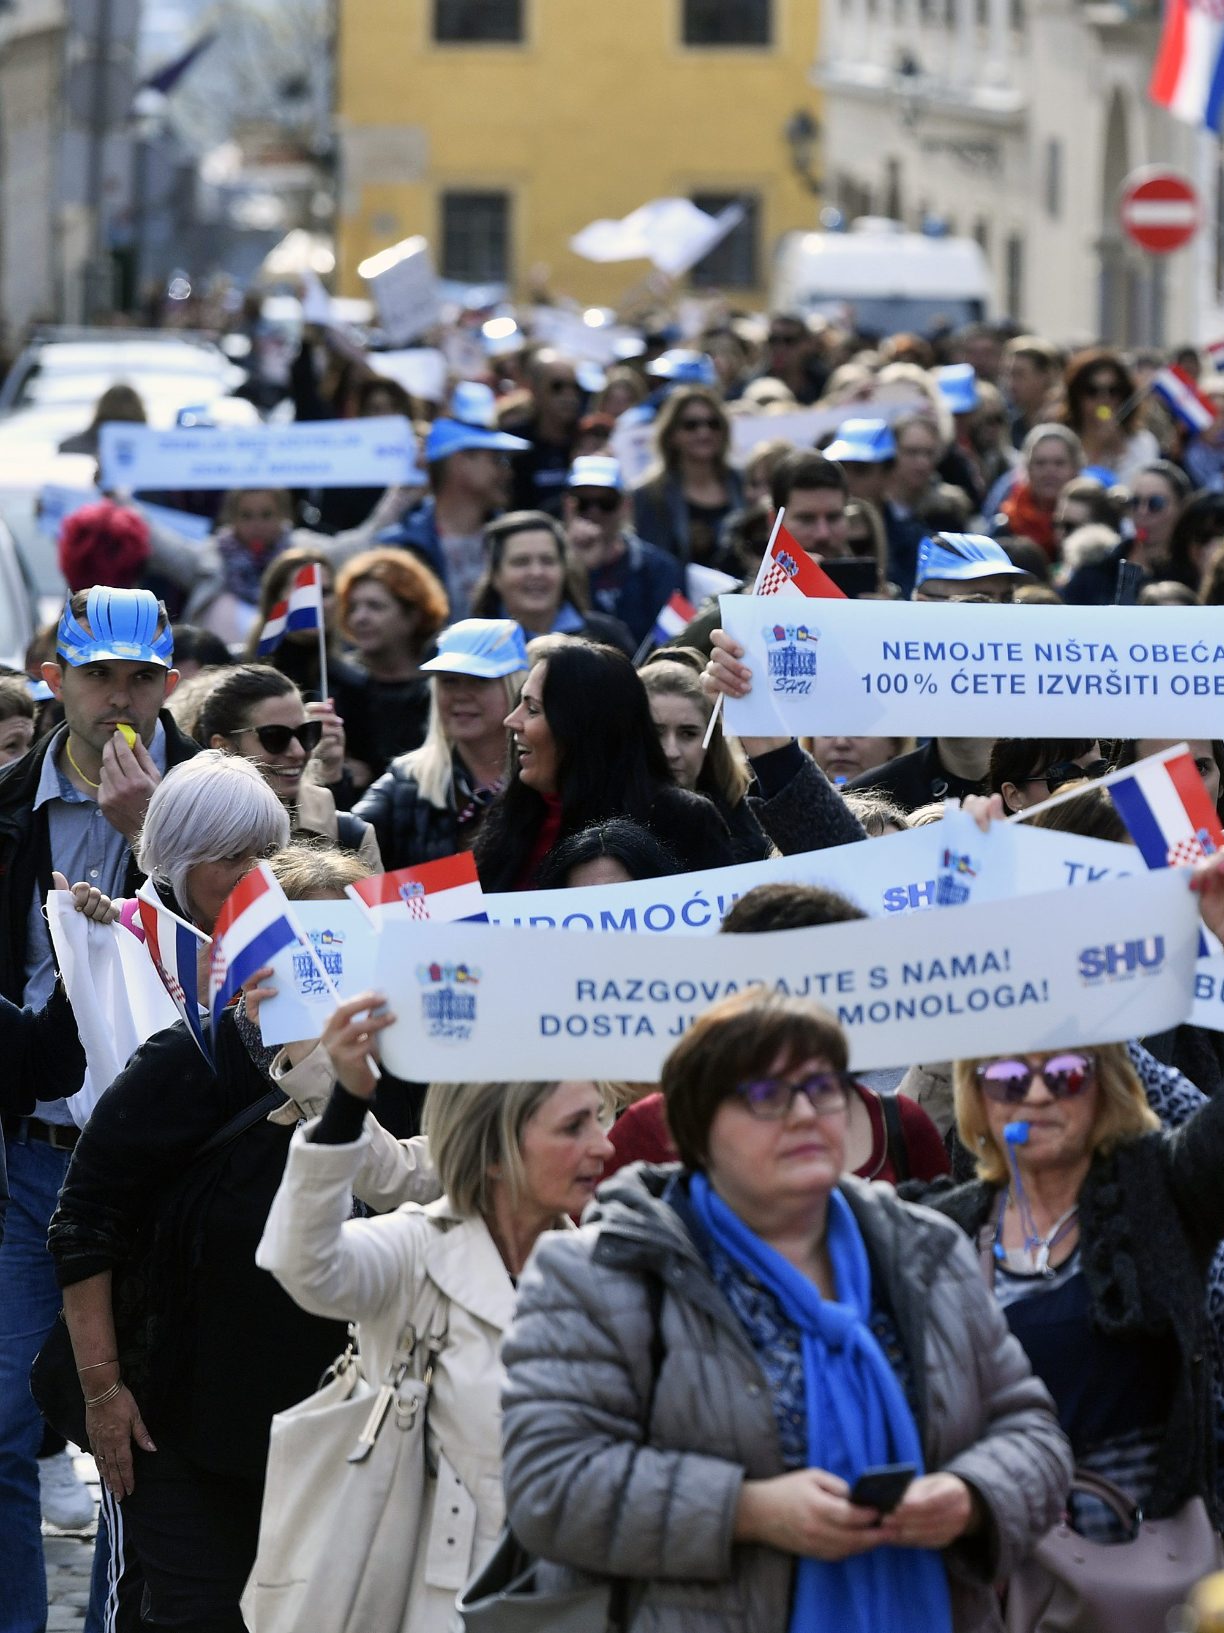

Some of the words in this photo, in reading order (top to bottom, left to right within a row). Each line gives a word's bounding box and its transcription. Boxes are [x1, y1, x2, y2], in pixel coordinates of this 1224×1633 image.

[882, 640, 1024, 662] NEMOJTE
[1034, 638, 1118, 663] NIŠTA
[950, 667, 1027, 695] ĆETE
[1038, 669, 1159, 696] IZVRŠITI
[883, 880, 935, 912] SH
[869, 967, 888, 990] S
[902, 948, 1011, 986] NAMA!
[1077, 934, 1166, 979] SHU
[540, 1013, 654, 1037] DOSTA
[838, 980, 1049, 1026] MONOLOGA!
